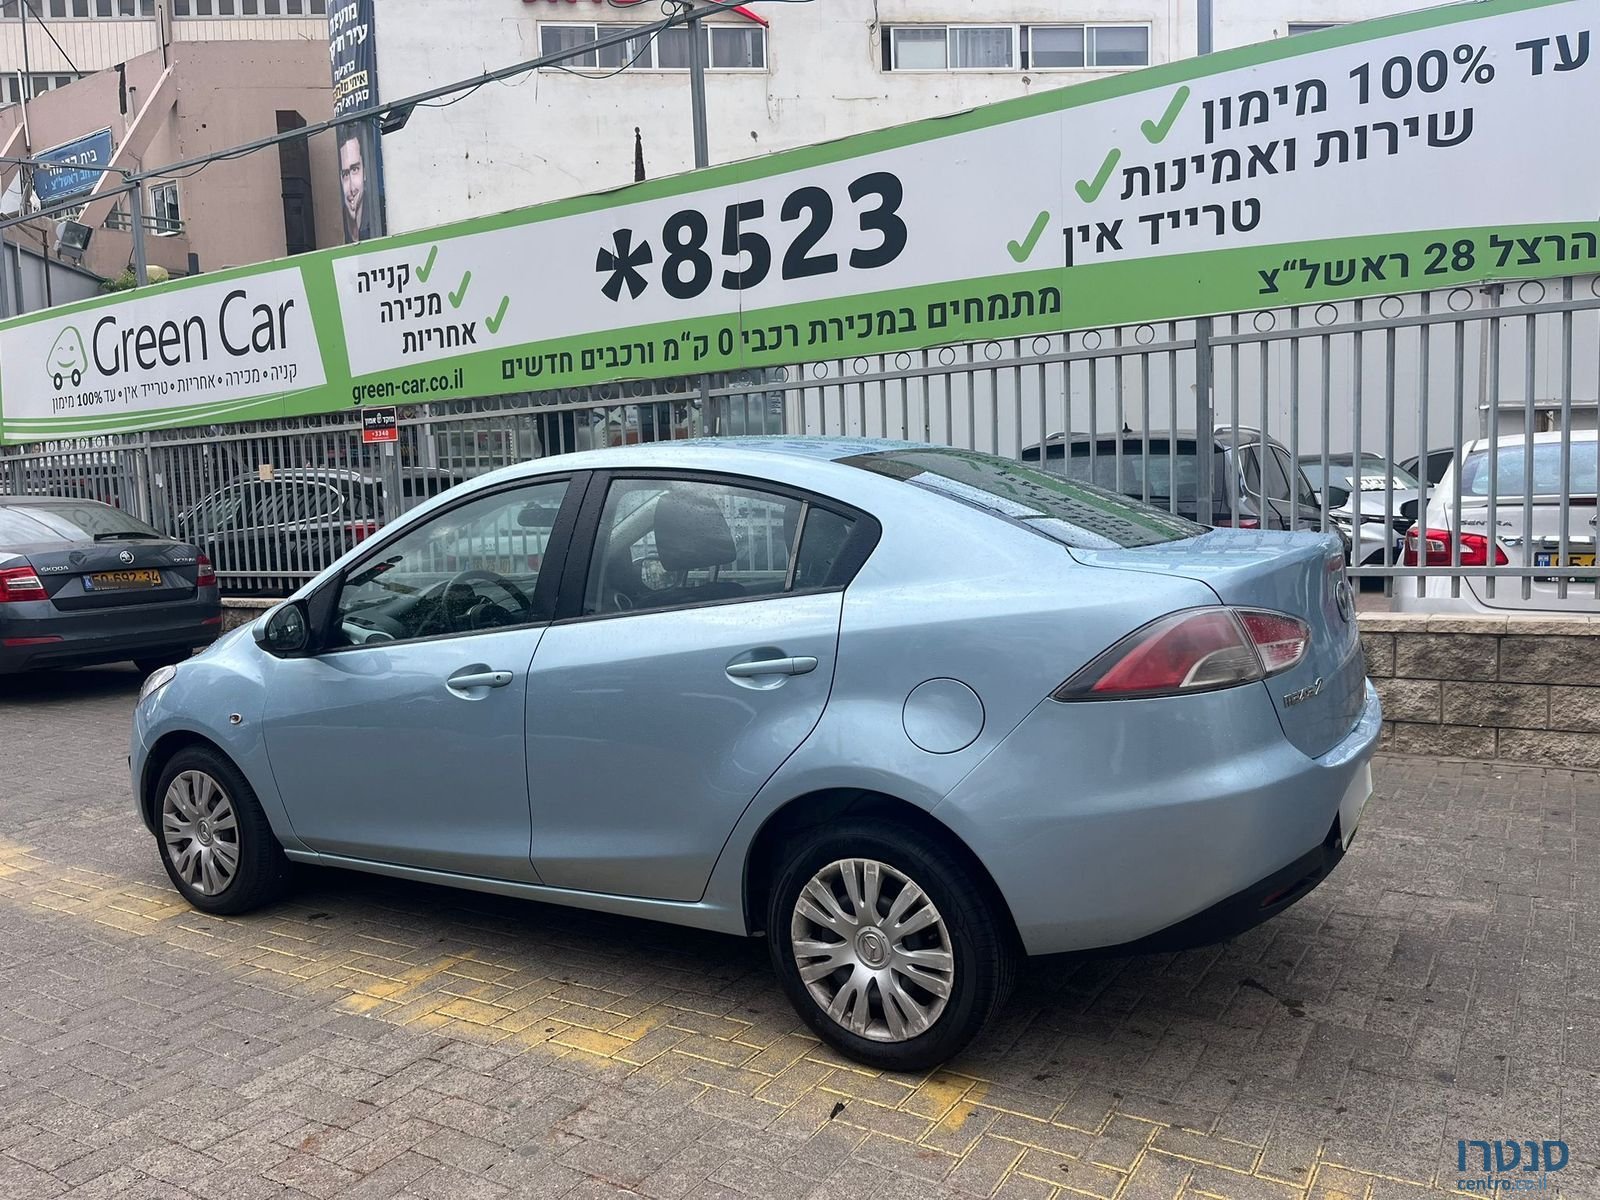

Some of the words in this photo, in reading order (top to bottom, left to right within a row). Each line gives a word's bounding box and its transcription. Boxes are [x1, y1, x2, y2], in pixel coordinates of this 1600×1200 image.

[345, 23, 368, 46] עיר
[1515, 30, 1590, 76] עד
[1349, 44, 1496, 105] 100%
[1202, 78, 1327, 144] מימון
[1313, 107, 1475, 168] שירות
[80, 149, 98, 165] בית
[1120, 137, 1297, 200] ואמינות
[1138, 197, 1262, 245] טרייד
[1063, 218, 1124, 268] אין
[1423, 239, 1475, 276] 28
[1489, 231, 1597, 268] הרצל
[357, 263, 410, 294] קנייה
[380, 292, 442, 324] מכירה
[928, 286, 1061, 328] מתמחים
[92, 315, 208, 376] Green
[218, 289, 294, 356] Car
[402, 321, 477, 354] אחריות
[718, 327, 734, 356] 0
[741, 324, 799, 354] רכבי
[807, 307, 917, 345] במכירת
[501, 351, 573, 380] חדשים
[581, 341, 654, 371] ורכבים
[140, 381, 168, 397] טרייד
[177, 374, 216, 393] אחריות
[225, 368, 260, 387] מכירה
[270, 363, 297, 384] קניה
[352, 368, 463, 404] green-car.co.il
[52, 395, 75, 414] מימון
[76, 390, 103, 407] 100%
[103, 388, 116, 403] עד
[123, 385, 138, 404] אין
